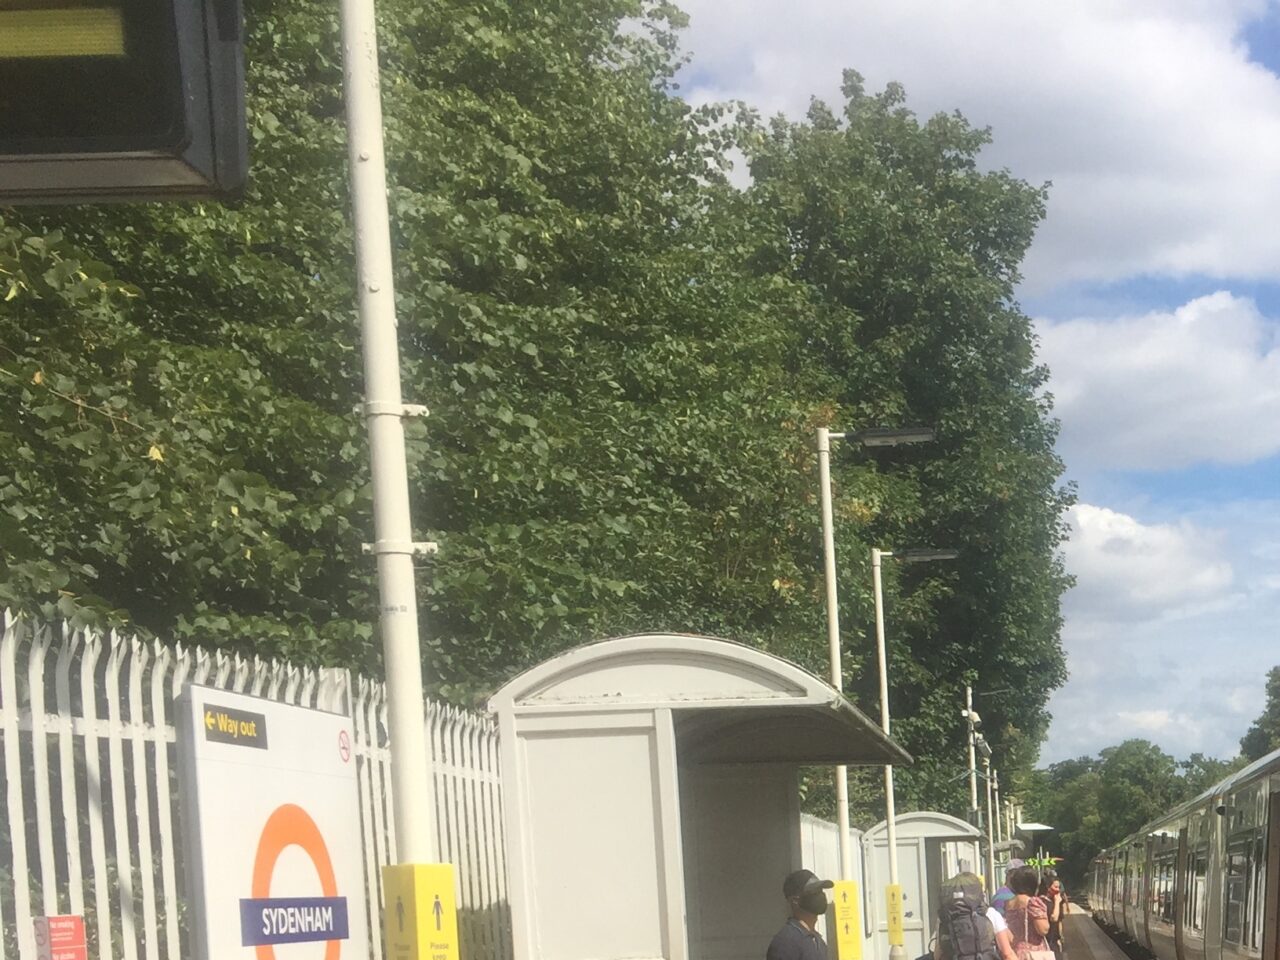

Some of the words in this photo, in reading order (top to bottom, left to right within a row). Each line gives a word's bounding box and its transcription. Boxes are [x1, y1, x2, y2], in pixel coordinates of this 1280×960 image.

[216, 711, 239, 738] Way
[240, 720, 257, 737] out
[262, 906, 333, 935] SYDENHAM
[430, 941, 449, 950] Please
